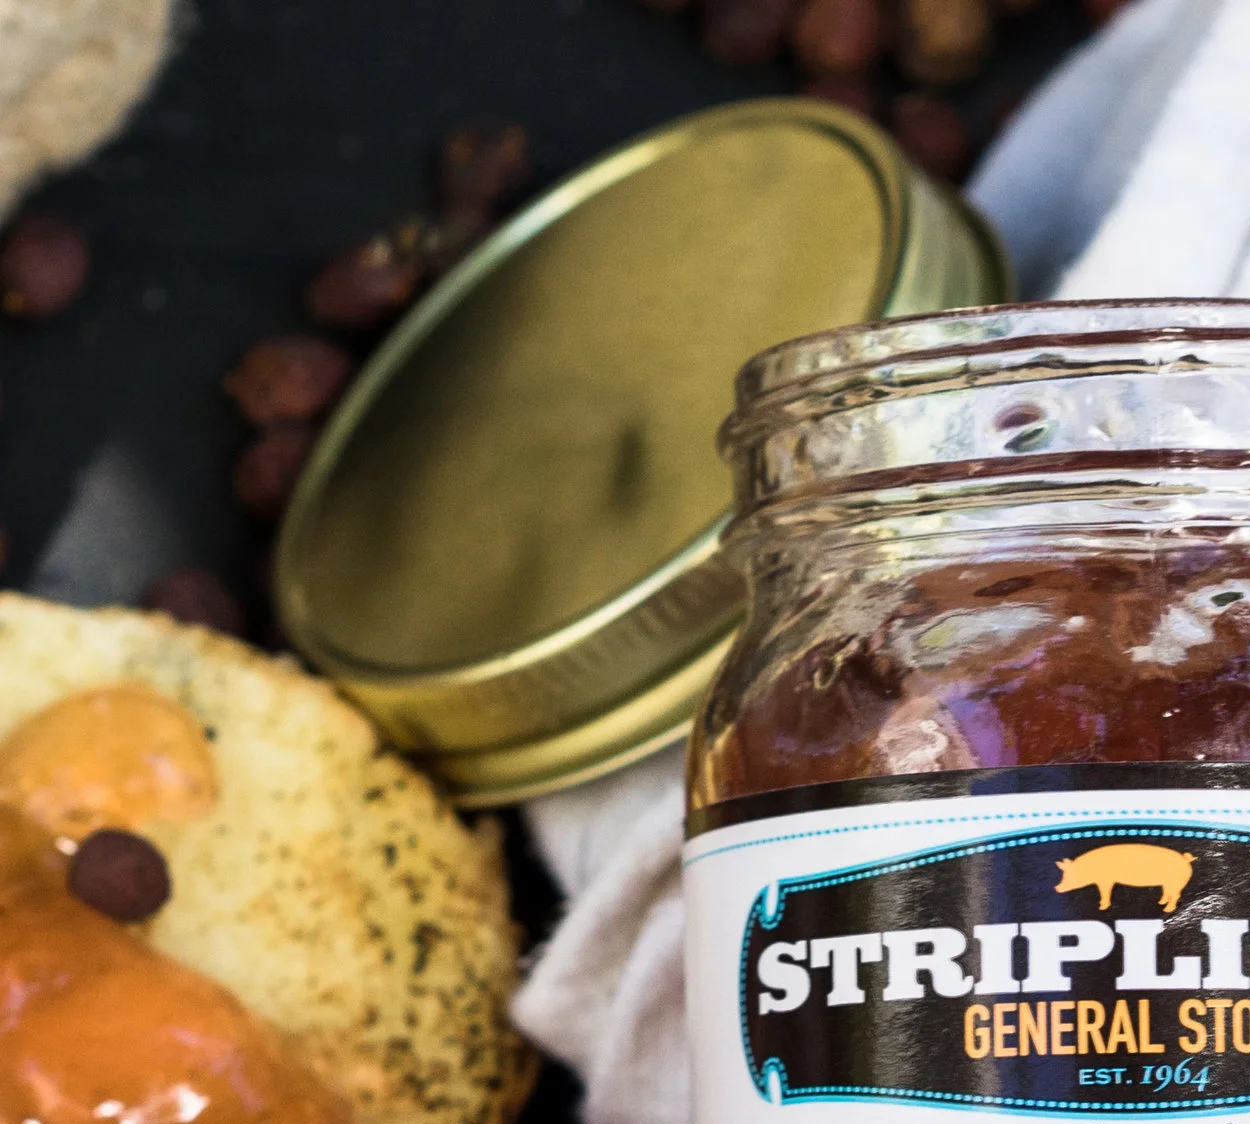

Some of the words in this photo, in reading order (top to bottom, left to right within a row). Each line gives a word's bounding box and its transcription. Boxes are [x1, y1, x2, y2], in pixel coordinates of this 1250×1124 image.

[963, 1001, 1164, 1060] GENERAL
[1078, 1067, 1133, 1087] EST.
[1141, 1057, 1210, 1093] 1964
